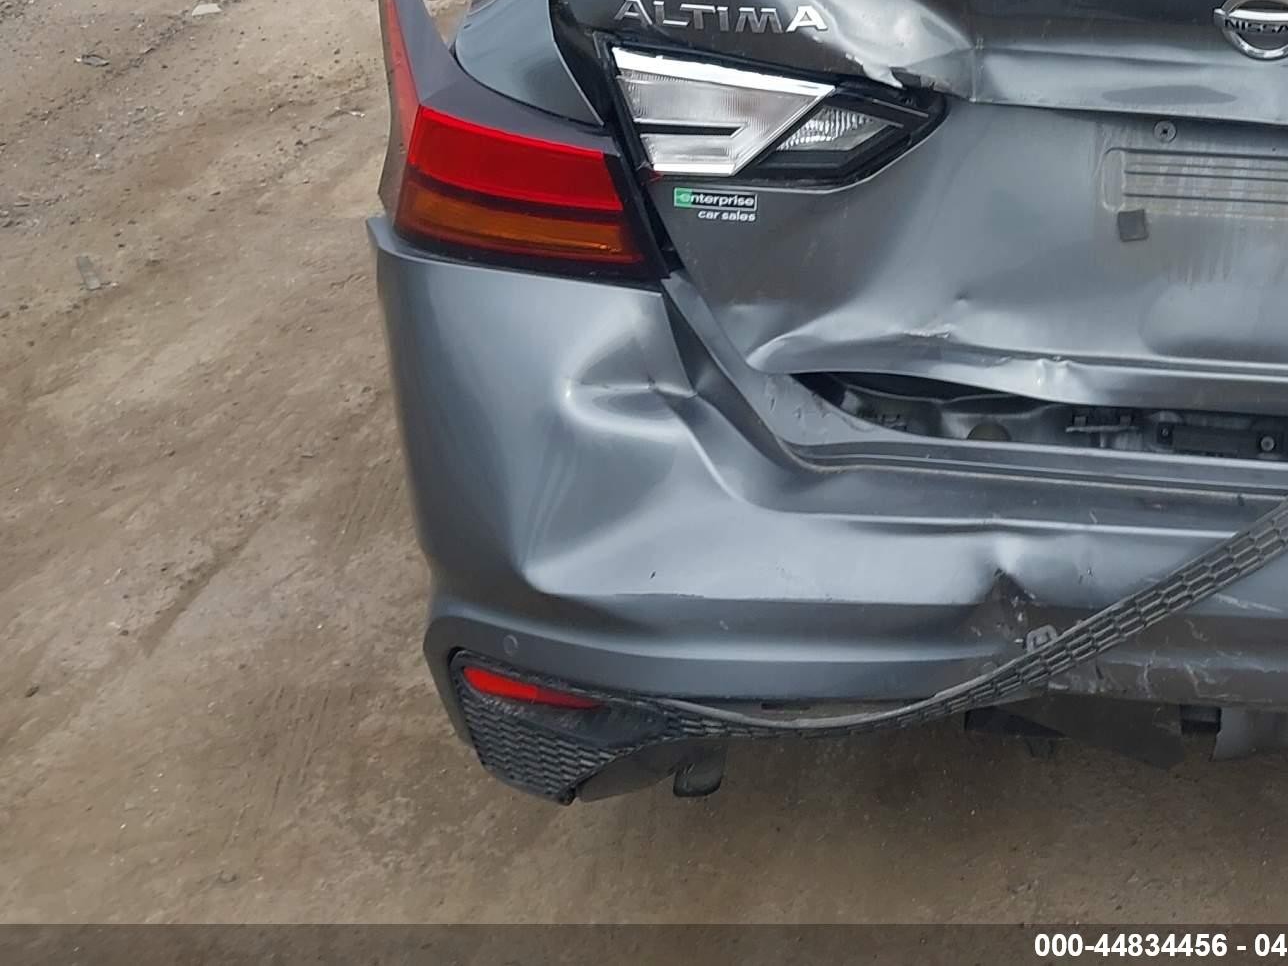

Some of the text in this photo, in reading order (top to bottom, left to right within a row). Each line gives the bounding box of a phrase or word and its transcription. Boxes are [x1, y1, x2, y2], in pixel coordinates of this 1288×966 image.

[679, 193, 755, 207] enterprise
[698, 210, 756, 222] car sales
